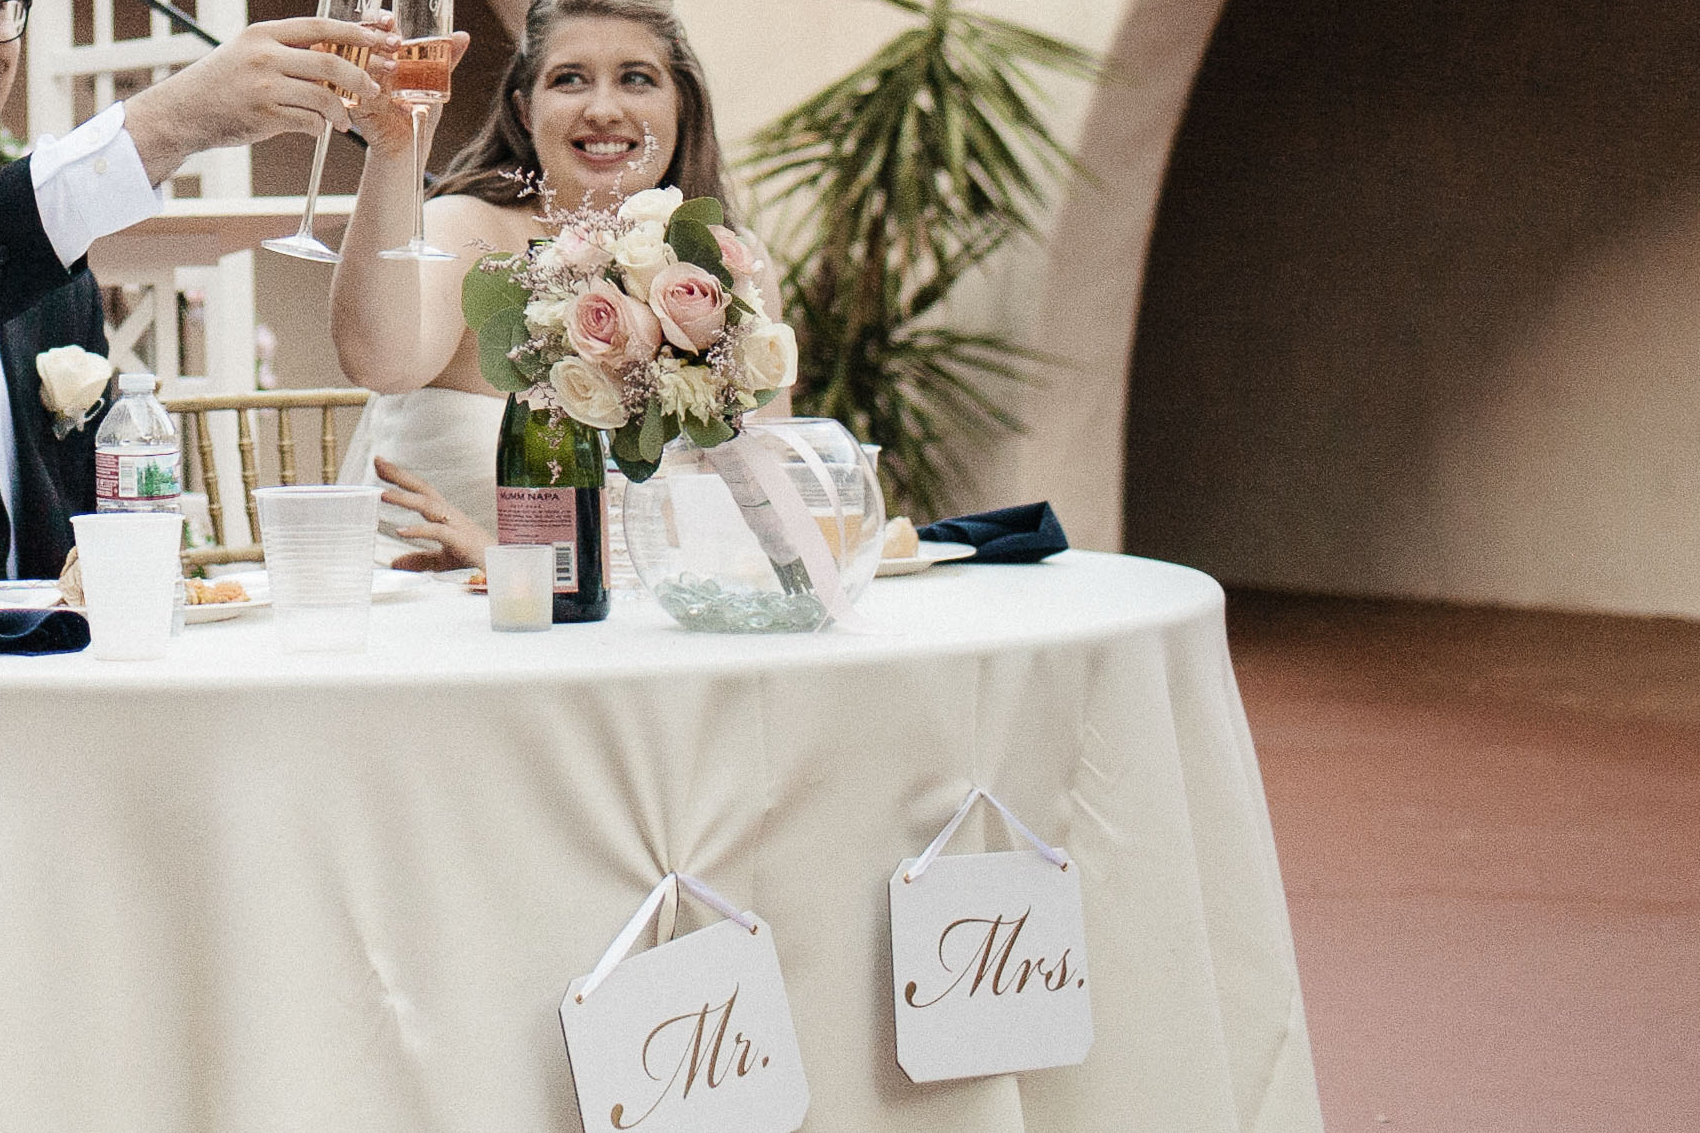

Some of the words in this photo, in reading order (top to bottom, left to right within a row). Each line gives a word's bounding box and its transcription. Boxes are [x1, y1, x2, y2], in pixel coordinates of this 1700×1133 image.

[499, 491, 525, 500] MUMM
[527, 492, 560, 501] NAPA
[905, 905, 1084, 1008] Mrs.
[610, 982, 770, 1130] Mr.
